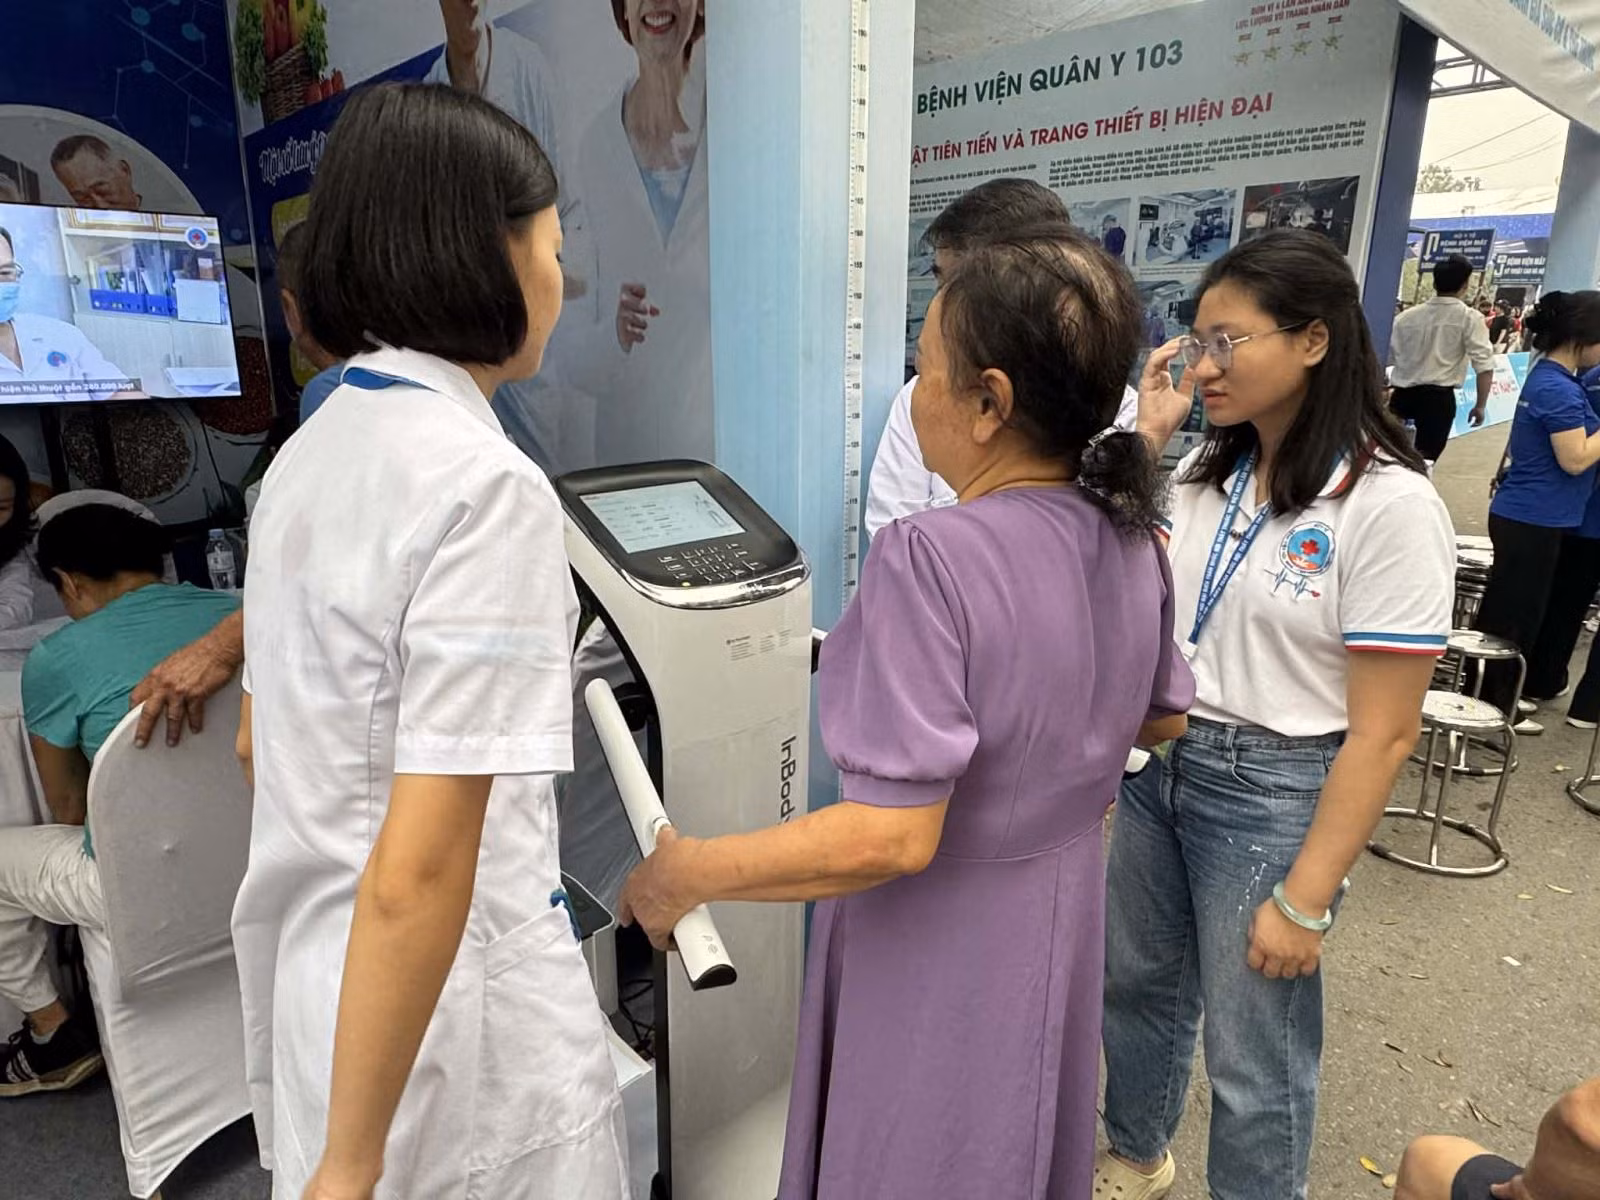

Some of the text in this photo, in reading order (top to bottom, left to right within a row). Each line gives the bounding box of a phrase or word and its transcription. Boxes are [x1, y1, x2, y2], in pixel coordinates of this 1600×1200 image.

[916, 39, 1183, 117] BỆNH VIỆN QUÂN Y 103
[933, 139, 961, 161] TIÊN
[967, 130, 998, 156] TIẾN
[1002, 127, 1025, 150] VÀ
[1030, 121, 1089, 146] TRANG
[1095, 106, 1144, 137] THIẾT
[1150, 109, 1168, 132] BỊ
[1175, 96, 1224, 127] HIỆN
[1231, 92, 1275, 119] ĐẠI
[781, 735, 797, 823] InBod
